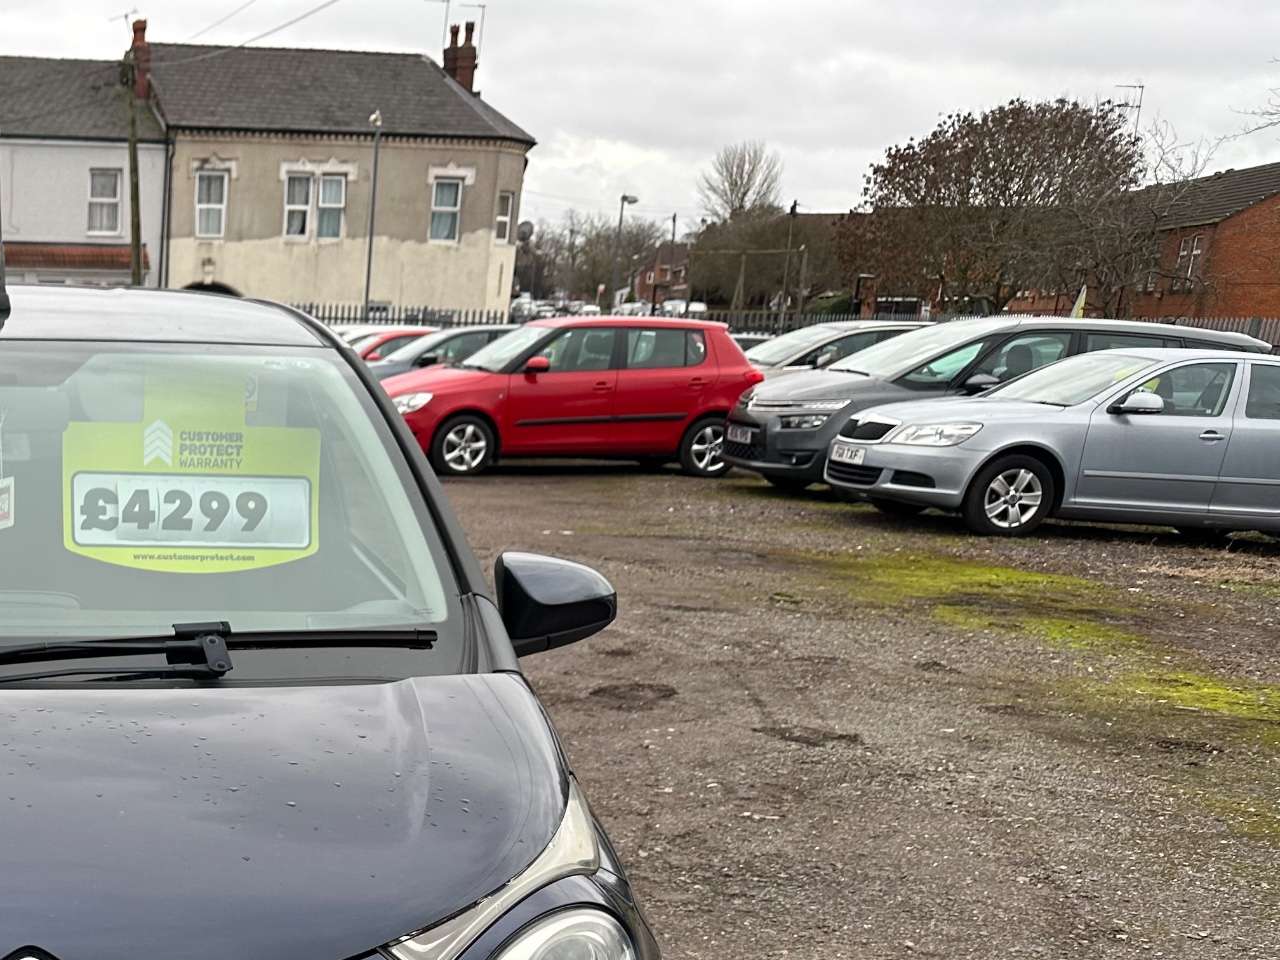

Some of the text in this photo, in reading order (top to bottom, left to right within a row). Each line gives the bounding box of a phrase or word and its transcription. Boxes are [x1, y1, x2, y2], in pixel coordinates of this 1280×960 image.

[179, 431, 244, 443] CUSTOMER
[179, 445, 243, 457] PROTECT
[178, 458, 242, 470] WARRANTY
[79, 487, 269, 533] £4299
[132, 552, 256, 563] www.customerprotect.com
